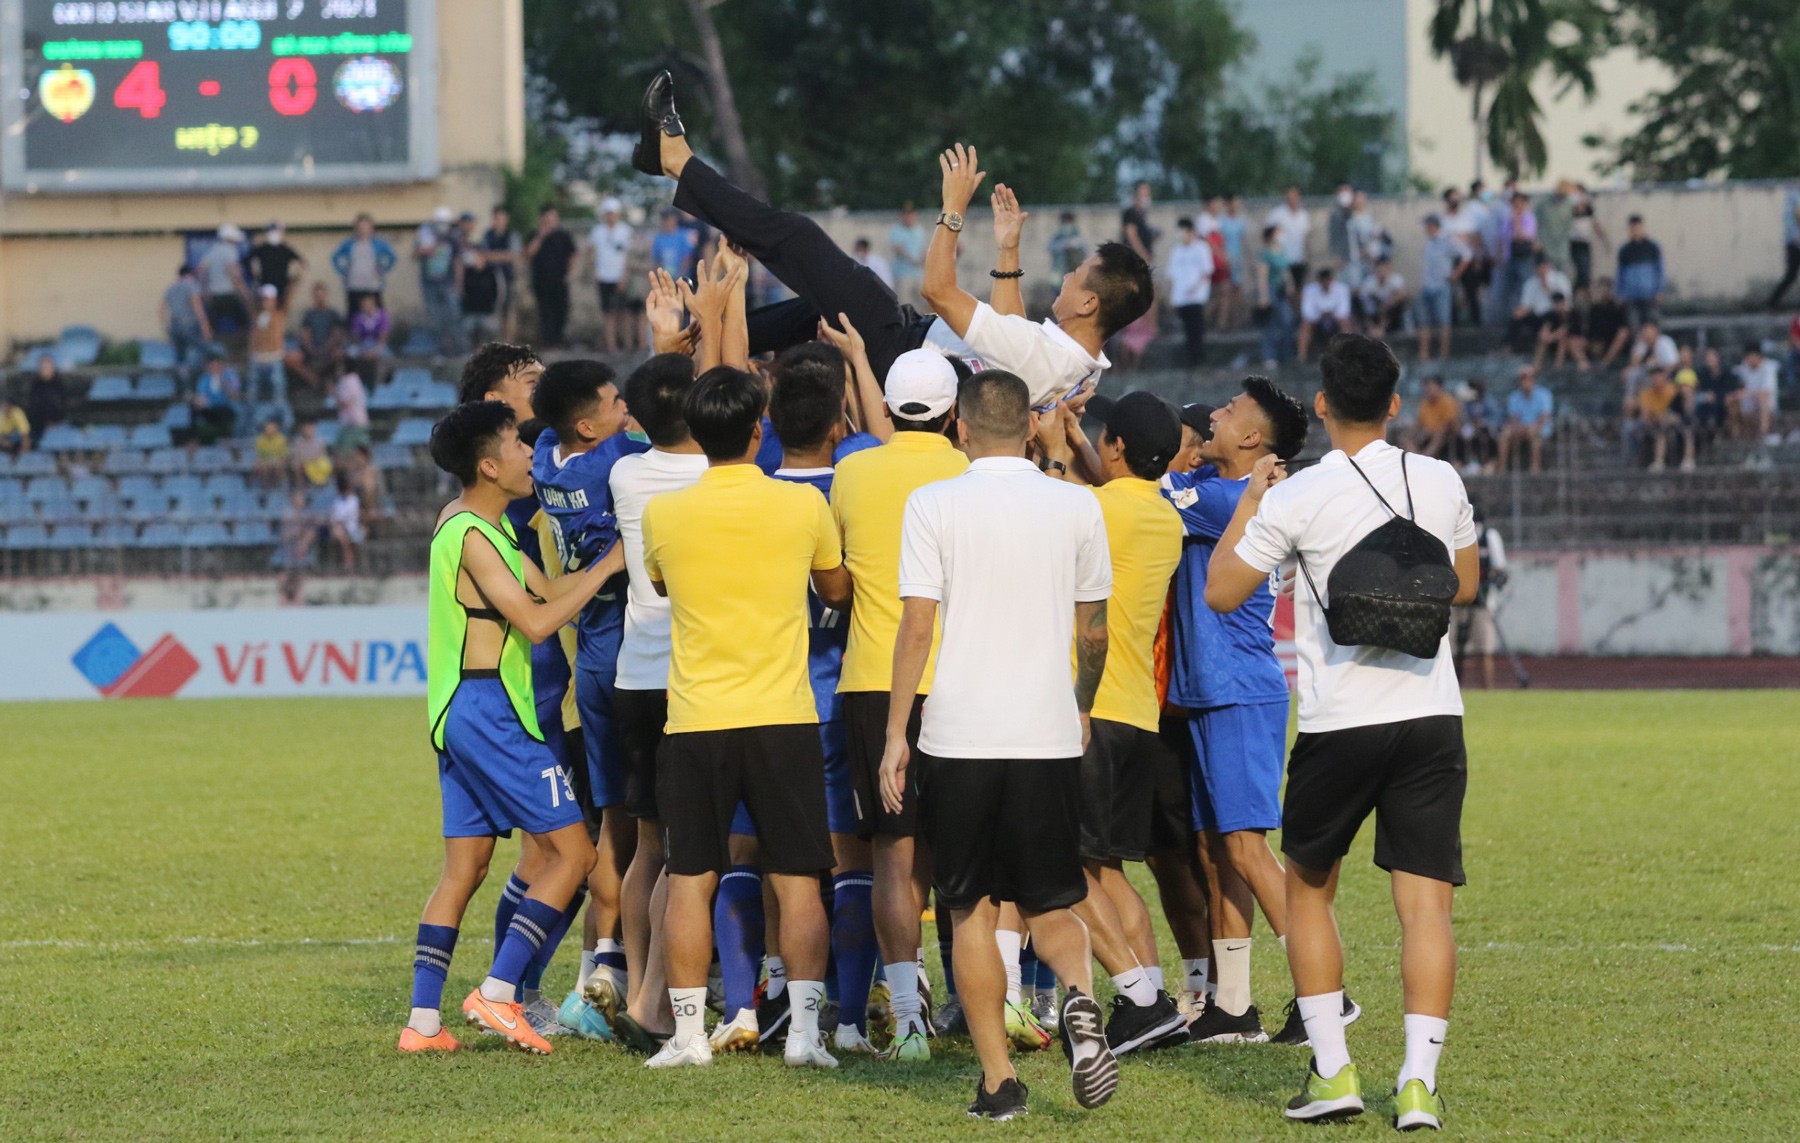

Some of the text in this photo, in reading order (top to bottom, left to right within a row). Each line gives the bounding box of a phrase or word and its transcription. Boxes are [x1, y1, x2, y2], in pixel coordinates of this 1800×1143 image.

[113, 60, 167, 118] 4
[268, 57, 318, 116] 0
[281, 639, 428, 685] VNPA
[541, 764, 577, 808] 73
[673, 1003, 698, 1017] 20
